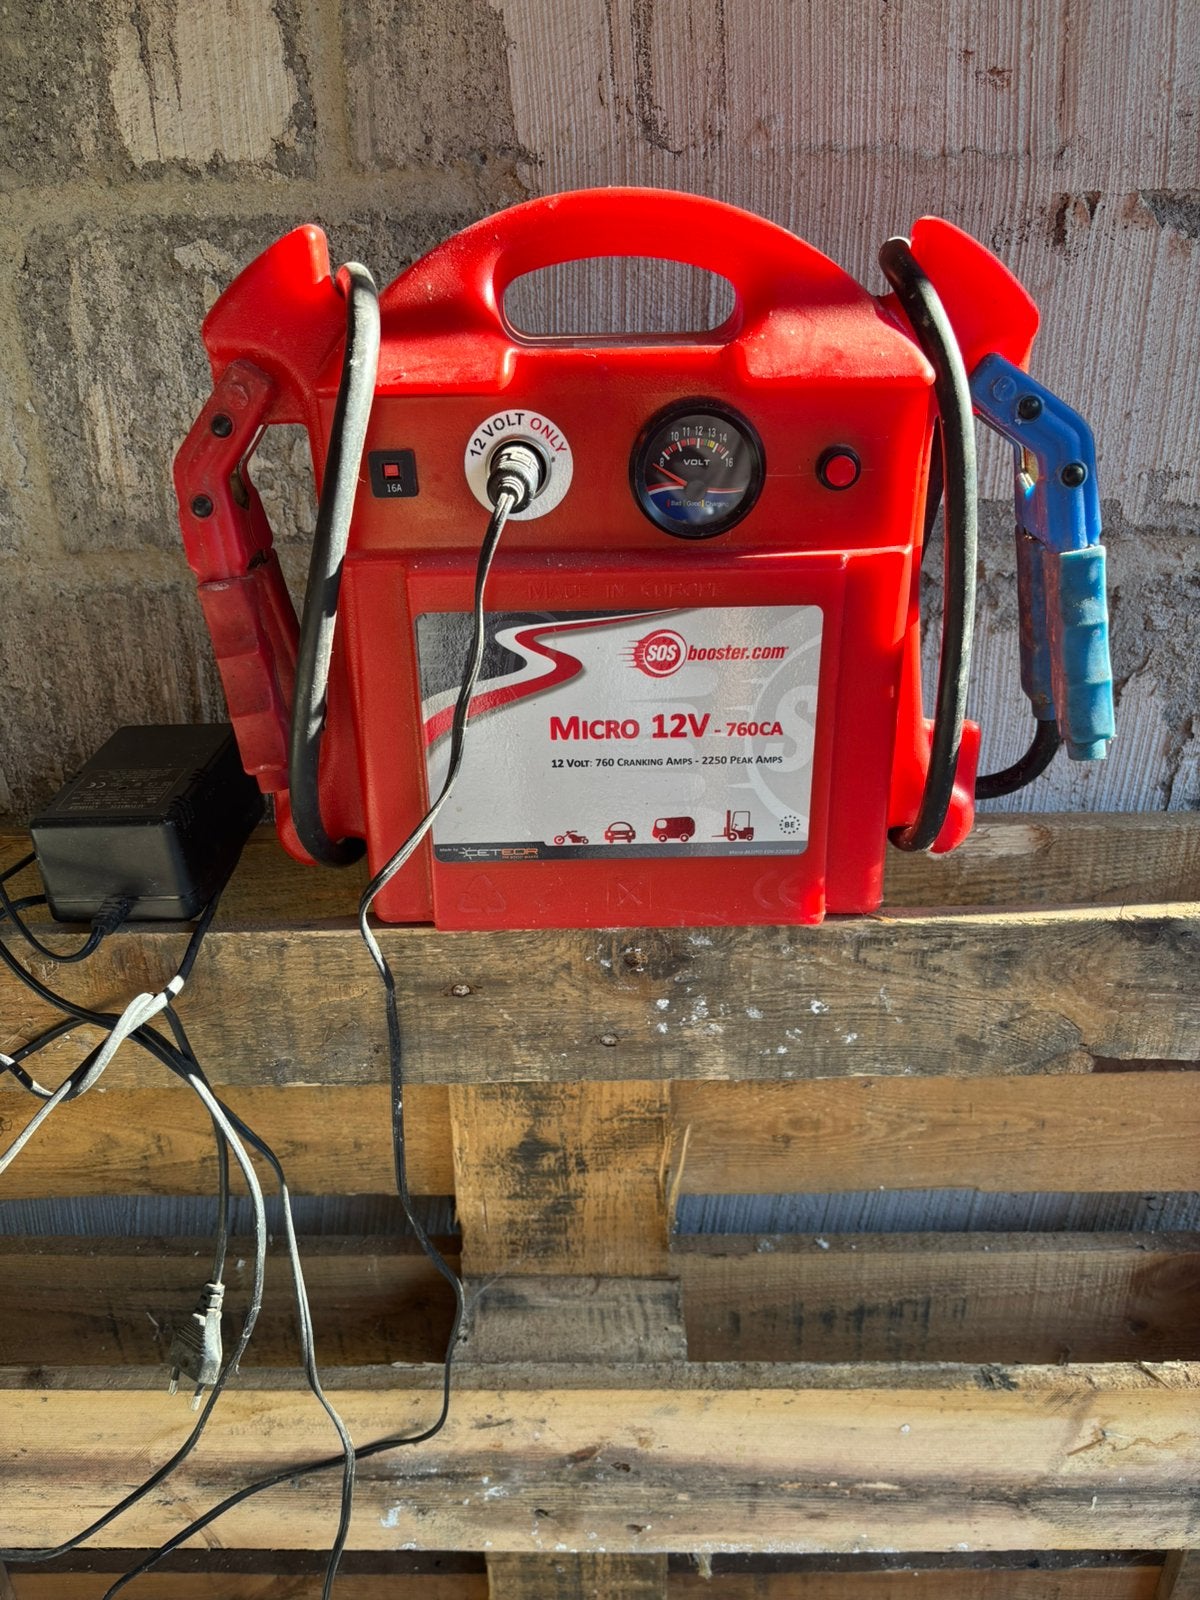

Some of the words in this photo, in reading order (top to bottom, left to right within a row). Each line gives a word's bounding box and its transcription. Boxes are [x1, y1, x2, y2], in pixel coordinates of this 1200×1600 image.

[470, 438, 486, 457] 12
[482, 412, 525, 438] VOLT
[530, 417, 567, 452] ONLY
[671, 431, 680, 441] 10
[682, 427, 690, 436] 11
[695, 426, 704, 436] 12
[708, 428, 716, 438] 13
[720, 433, 727, 442] 14
[659, 457, 665, 468] 8
[725, 457, 734, 467] 16
[386, 483, 402, 493] 16A
[646, 644, 678, 662] SOS
[687, 645, 789, 661] booster.com
[652, 713, 711, 739] 12V
[726, 721, 784, 737] 760CA
[551, 759, 565, 768] 12
[595, 758, 615, 767] 760
[702, 756, 728, 765] 2250
[784, 821, 796, 829] BE
